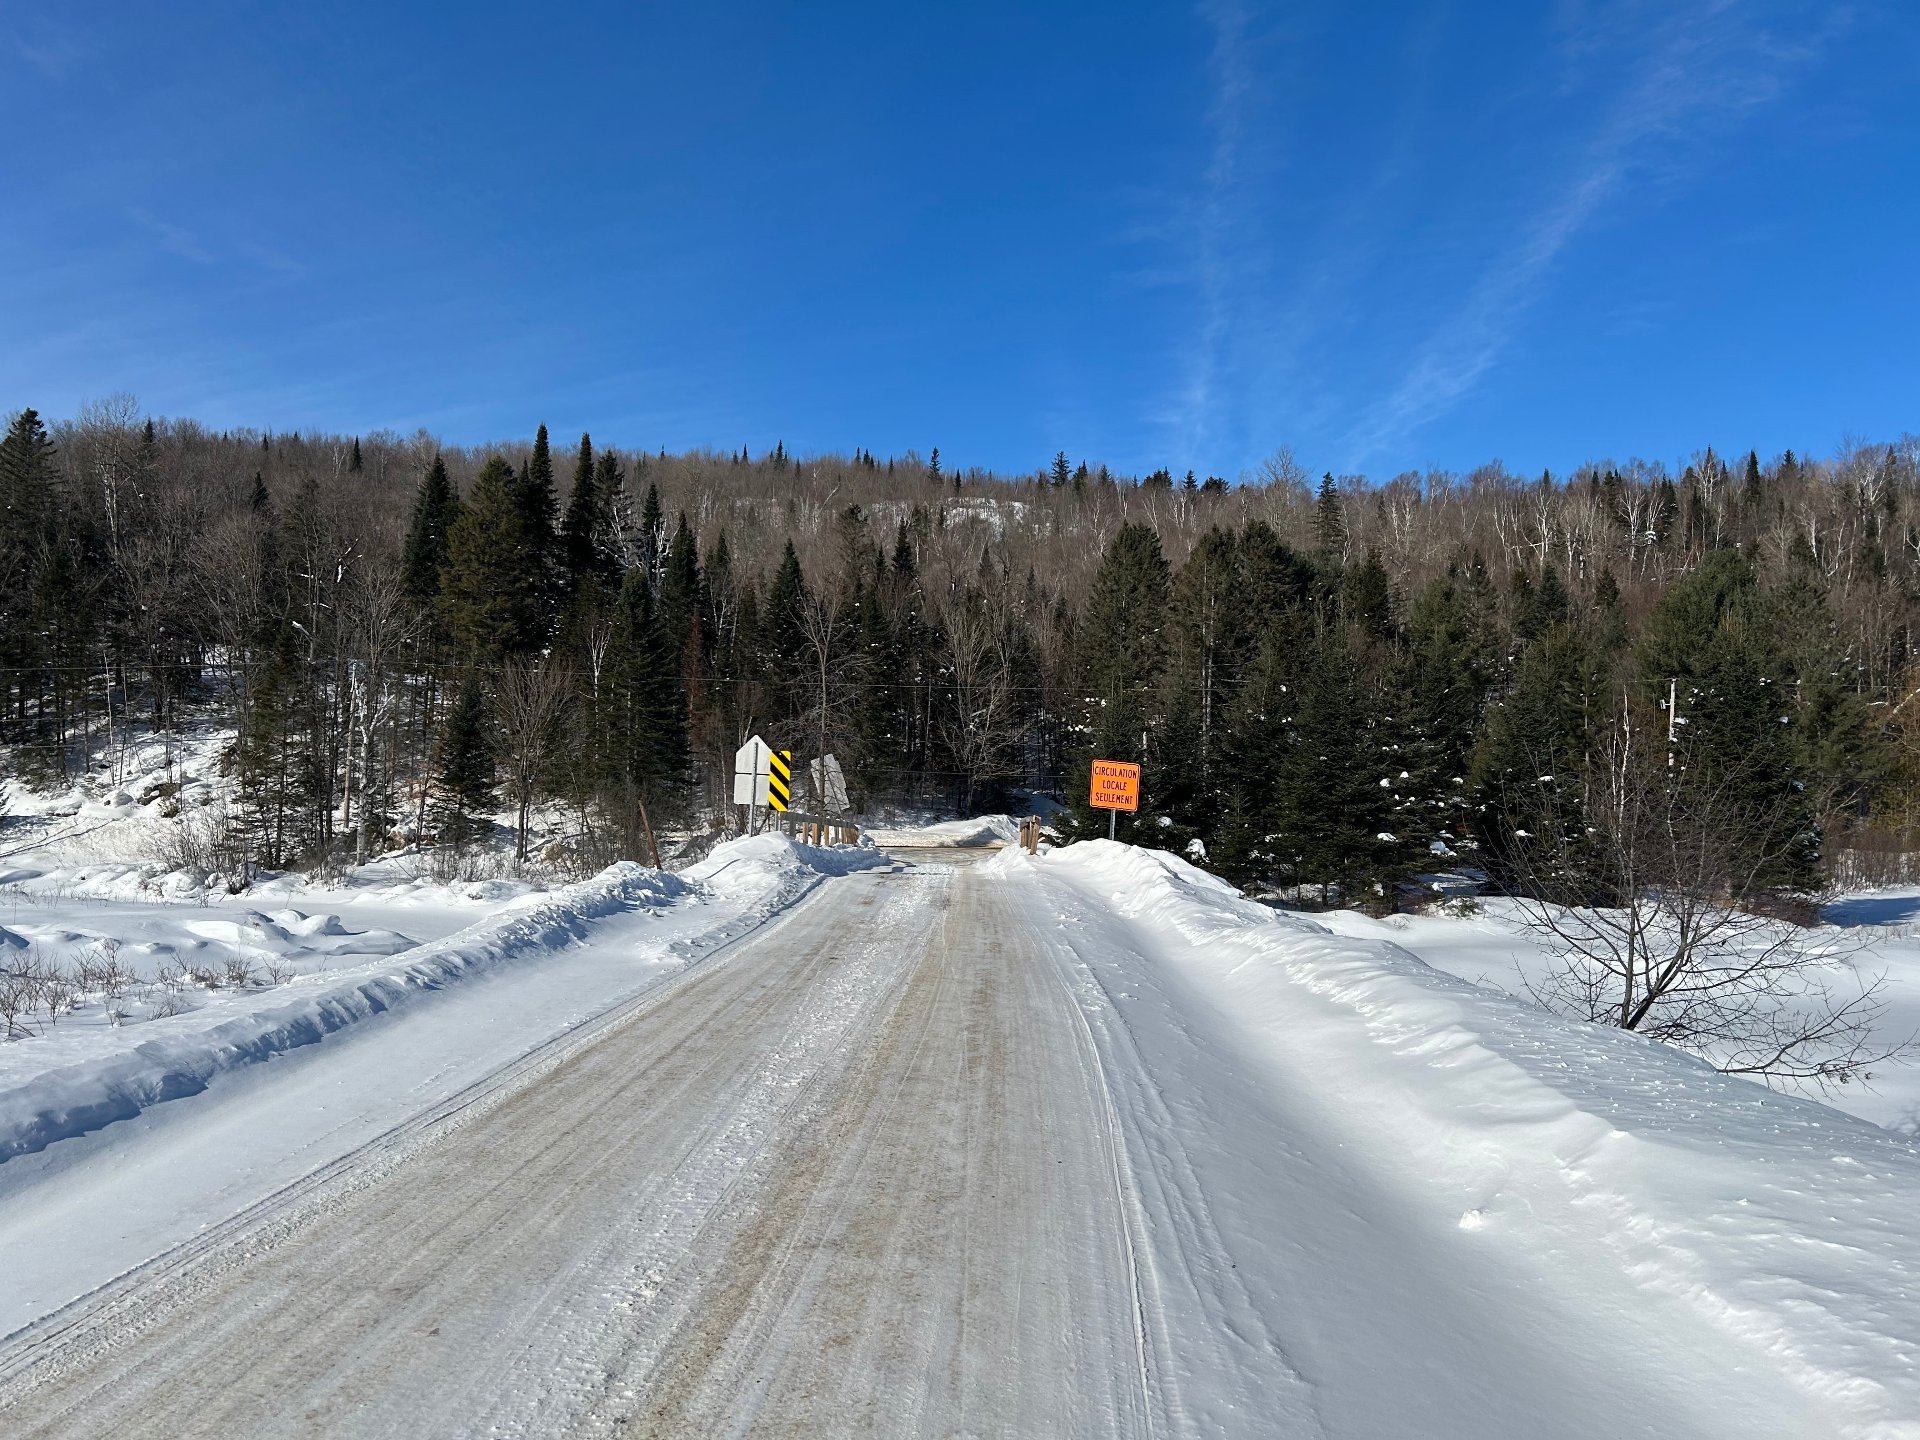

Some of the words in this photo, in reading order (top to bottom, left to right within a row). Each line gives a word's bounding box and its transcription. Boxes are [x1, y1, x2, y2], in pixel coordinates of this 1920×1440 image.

[1094, 766, 1137, 779] CIRCULATION
[1102, 780, 1127, 791] LOCALE
[1095, 792, 1133, 804] SEULEMENT
